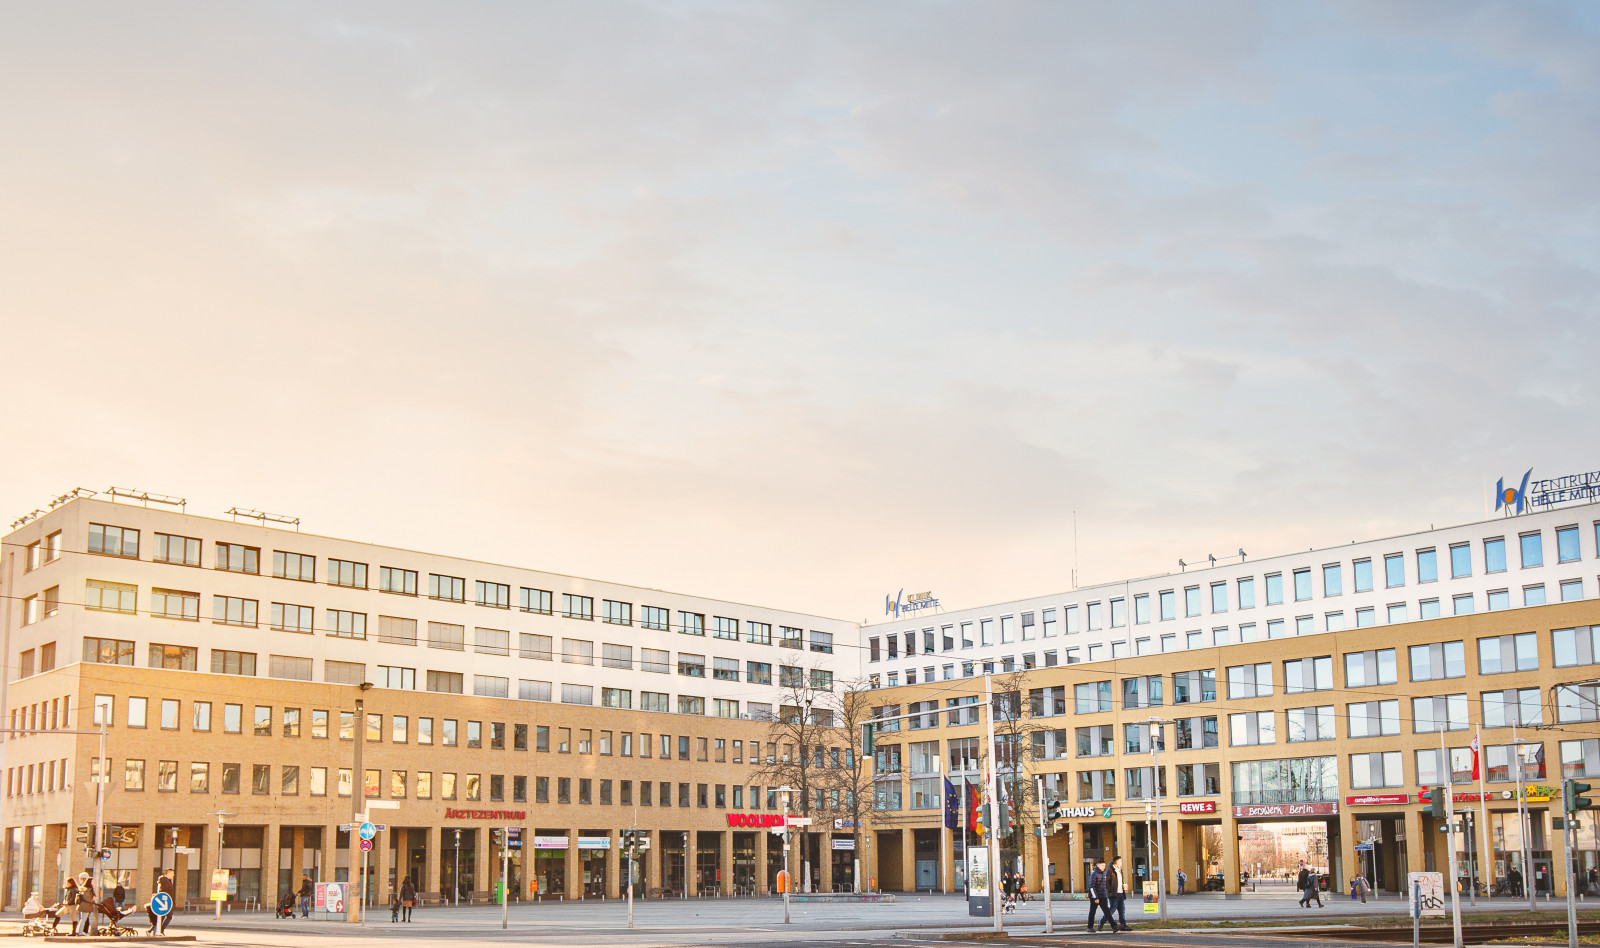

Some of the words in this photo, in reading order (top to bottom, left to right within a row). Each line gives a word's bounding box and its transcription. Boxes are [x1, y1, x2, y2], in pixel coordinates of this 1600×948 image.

[1531, 471, 1600, 494] ZENTRUM
[1536, 785, 1558, 799] PAZ
[445, 807, 526, 820] ÄRZTEZENTRUM
[1056, 806, 1095, 818] ATHAUS
[1181, 803, 1205, 812] REWE
[1289, 803, 1314, 814] Berlin
[727, 813, 803, 828] WOOLWO
